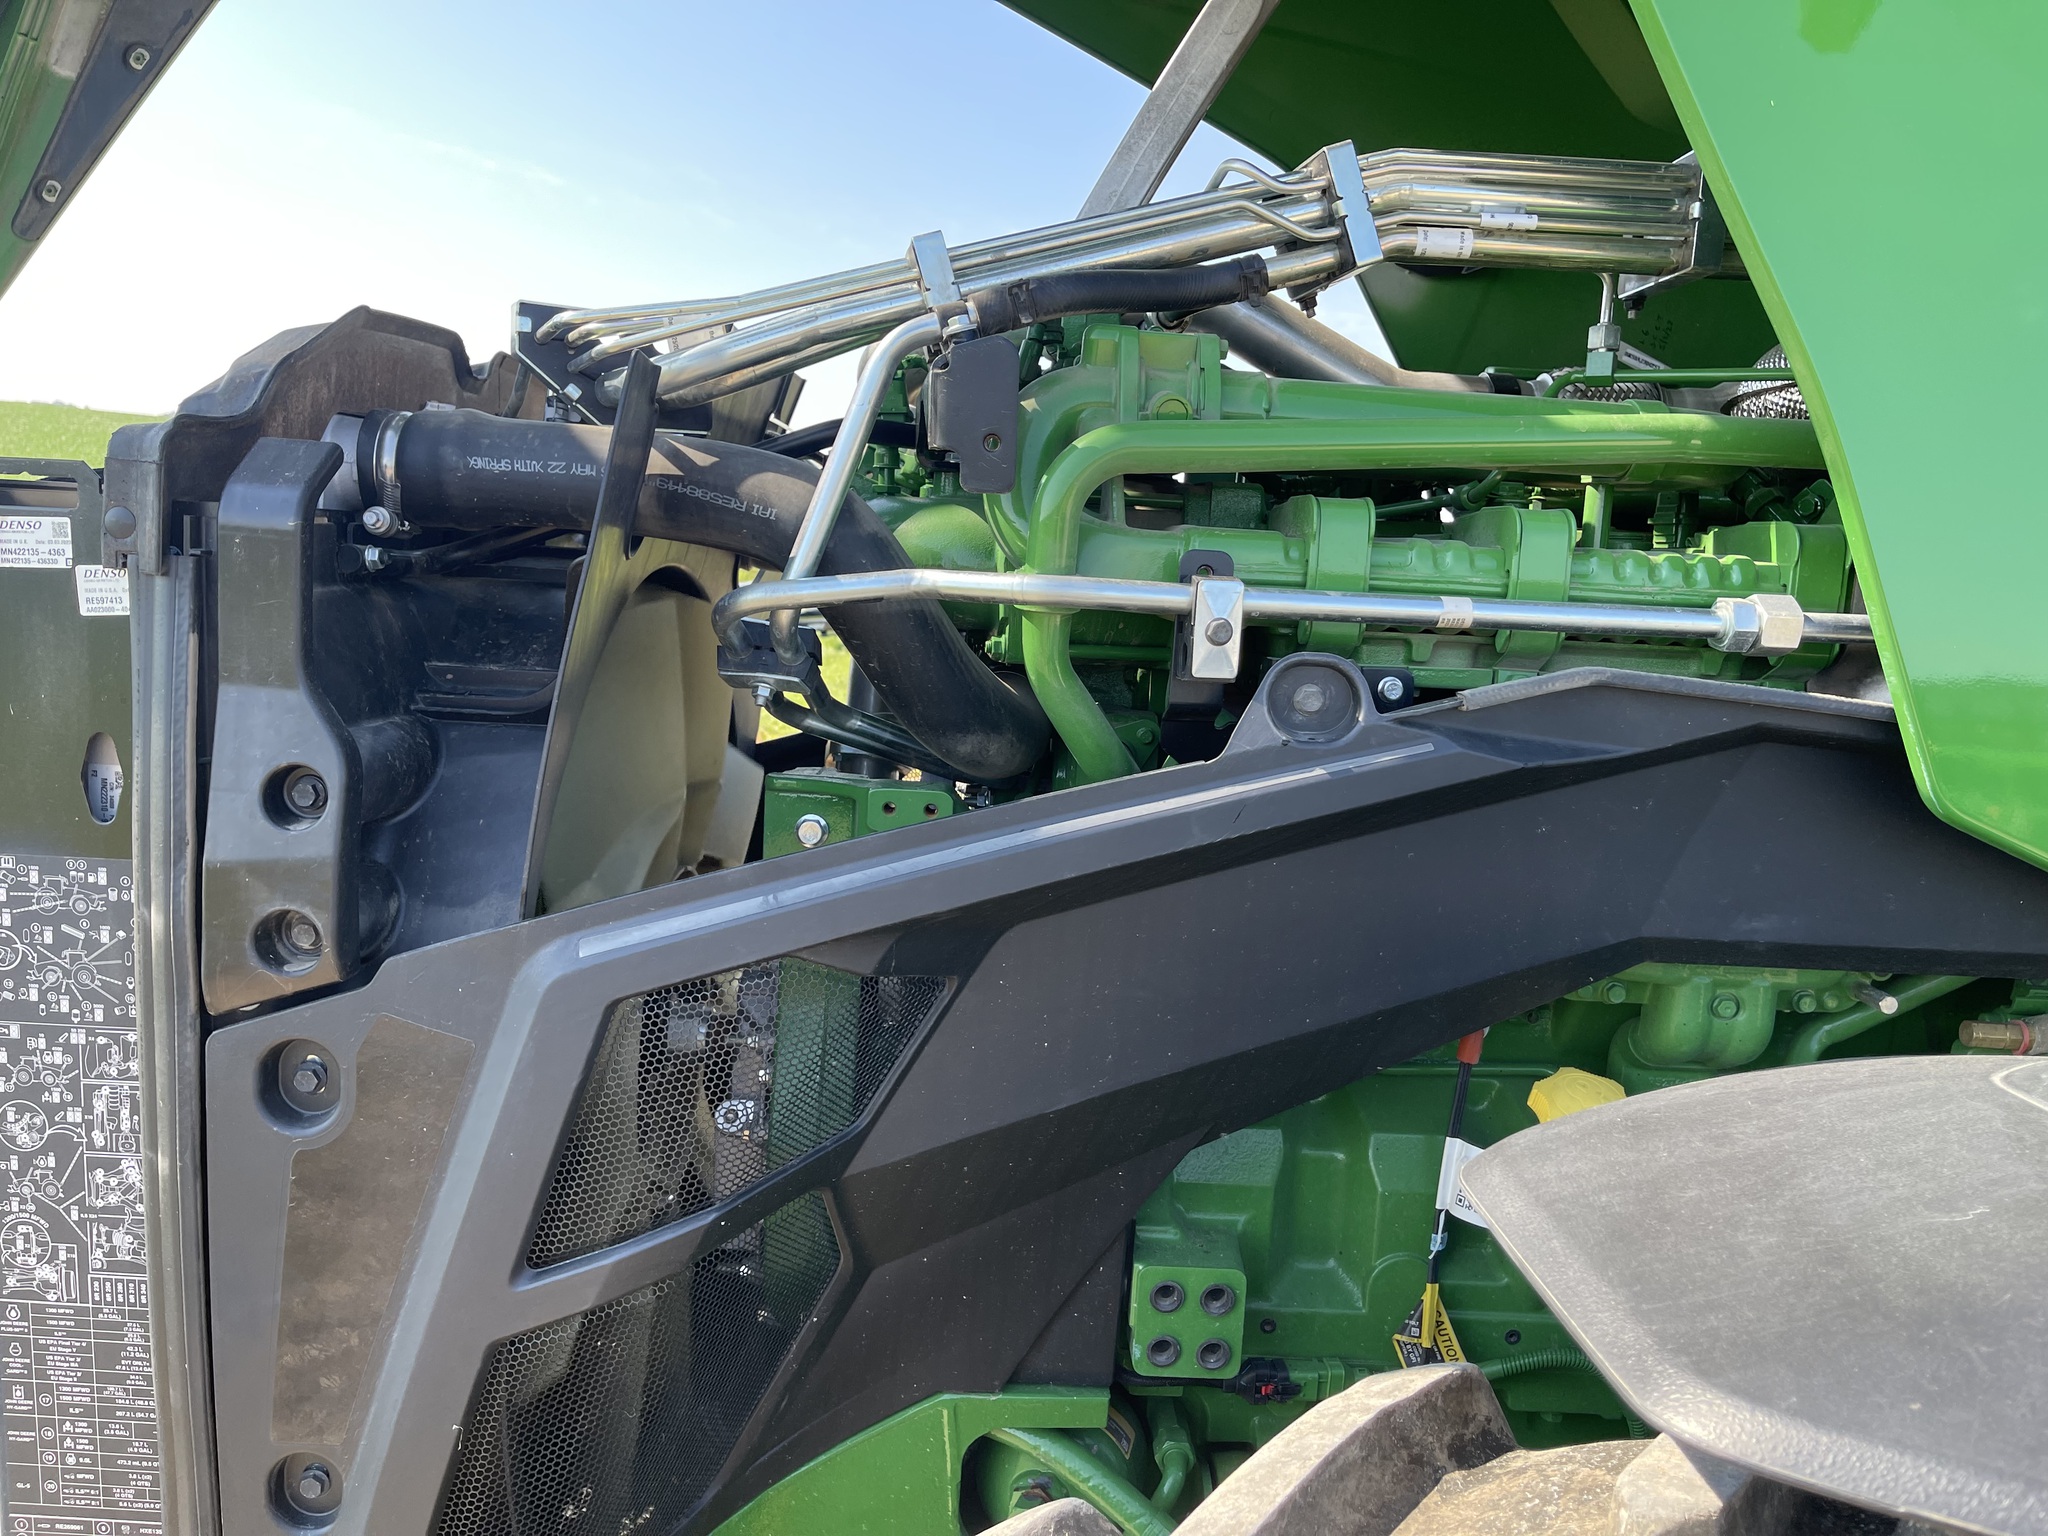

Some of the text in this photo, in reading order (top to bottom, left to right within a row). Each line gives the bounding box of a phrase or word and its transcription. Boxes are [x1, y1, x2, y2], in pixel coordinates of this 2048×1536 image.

[547, 461, 567, 474] 22
[571, 462, 596, 476] MAY
[0, 520, 42, 530] DENSO
[84, 569, 127, 578] DENSO
[86, 596, 122, 604] RE597413
